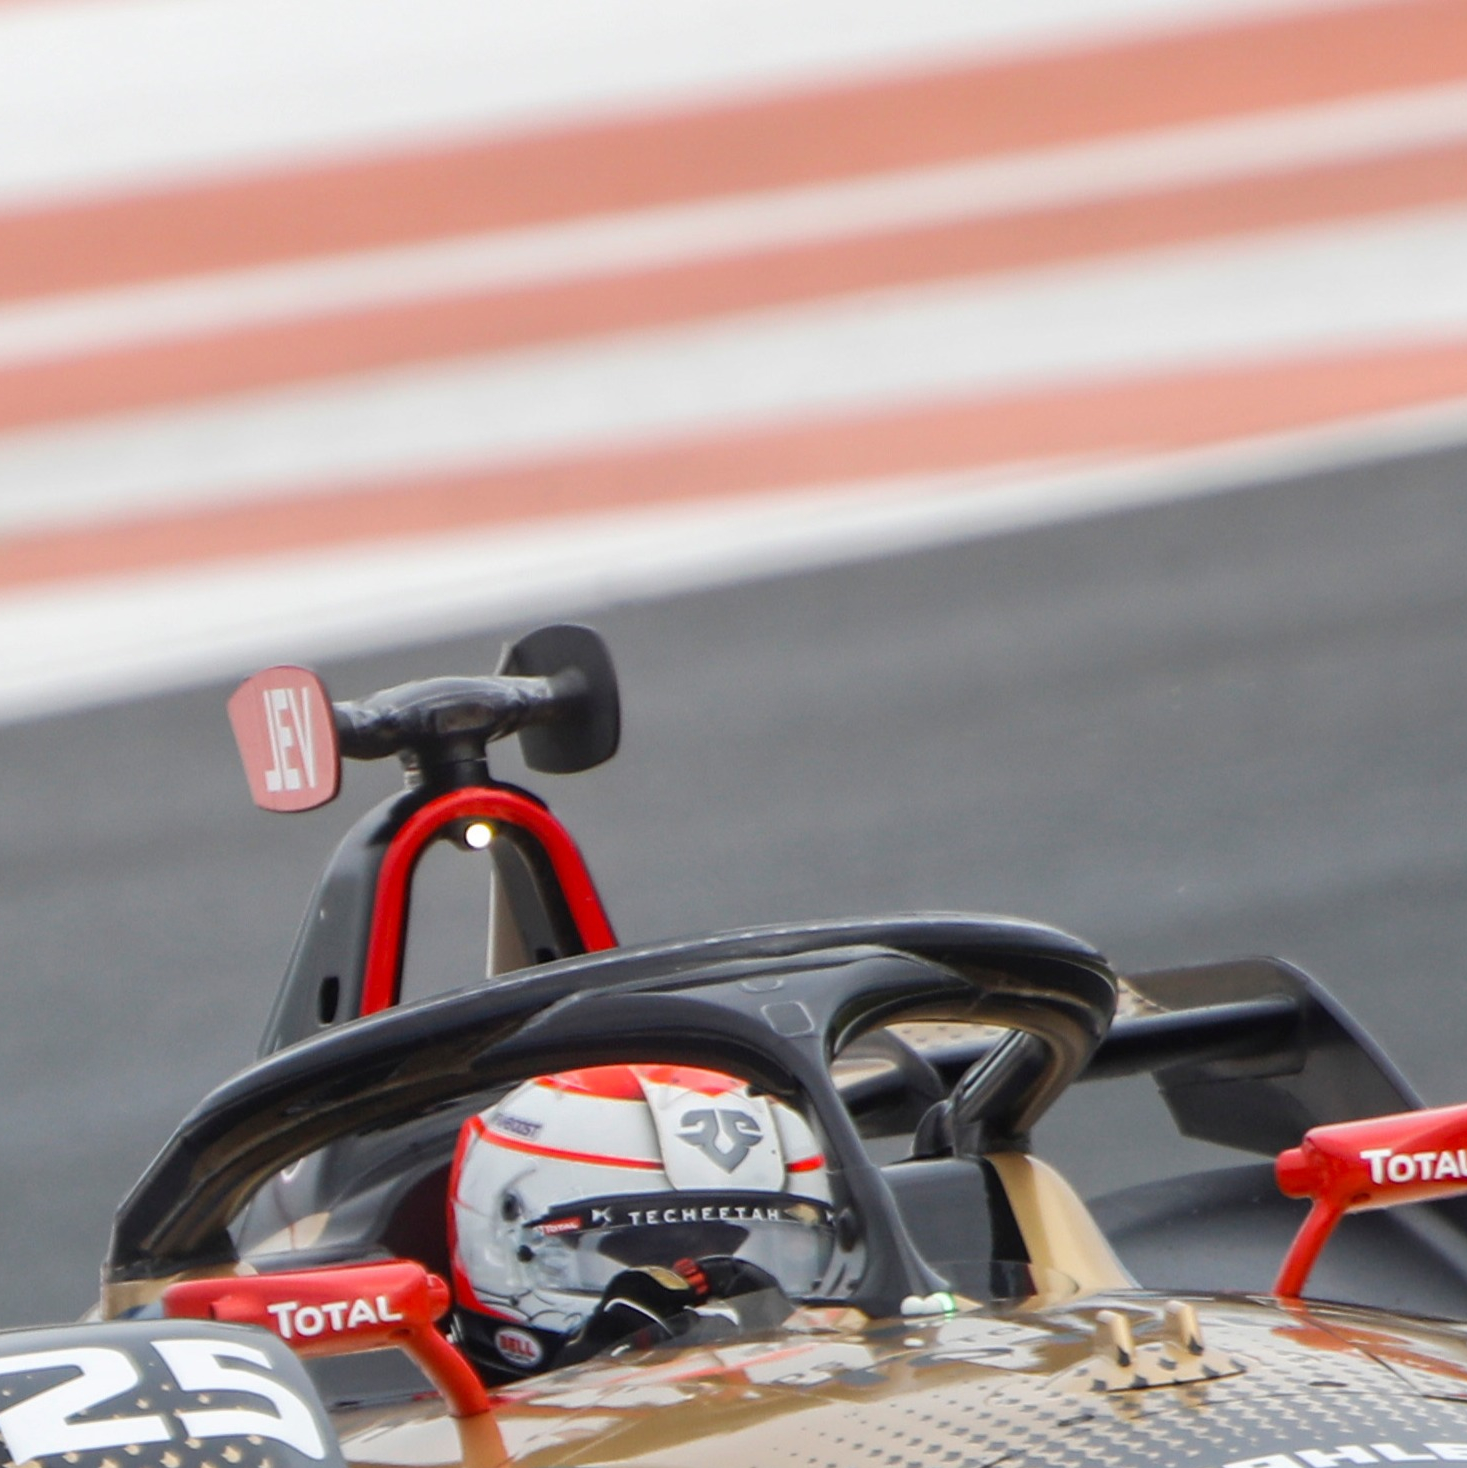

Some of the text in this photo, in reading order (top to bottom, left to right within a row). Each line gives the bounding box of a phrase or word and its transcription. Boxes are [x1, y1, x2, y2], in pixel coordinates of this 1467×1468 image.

[263, 686, 318, 793] JEV
[627, 1206, 781, 1226] TECHEETAH
[267, 1296, 403, 1339] TOTAL
[499, 1335, 537, 1358] BELL
